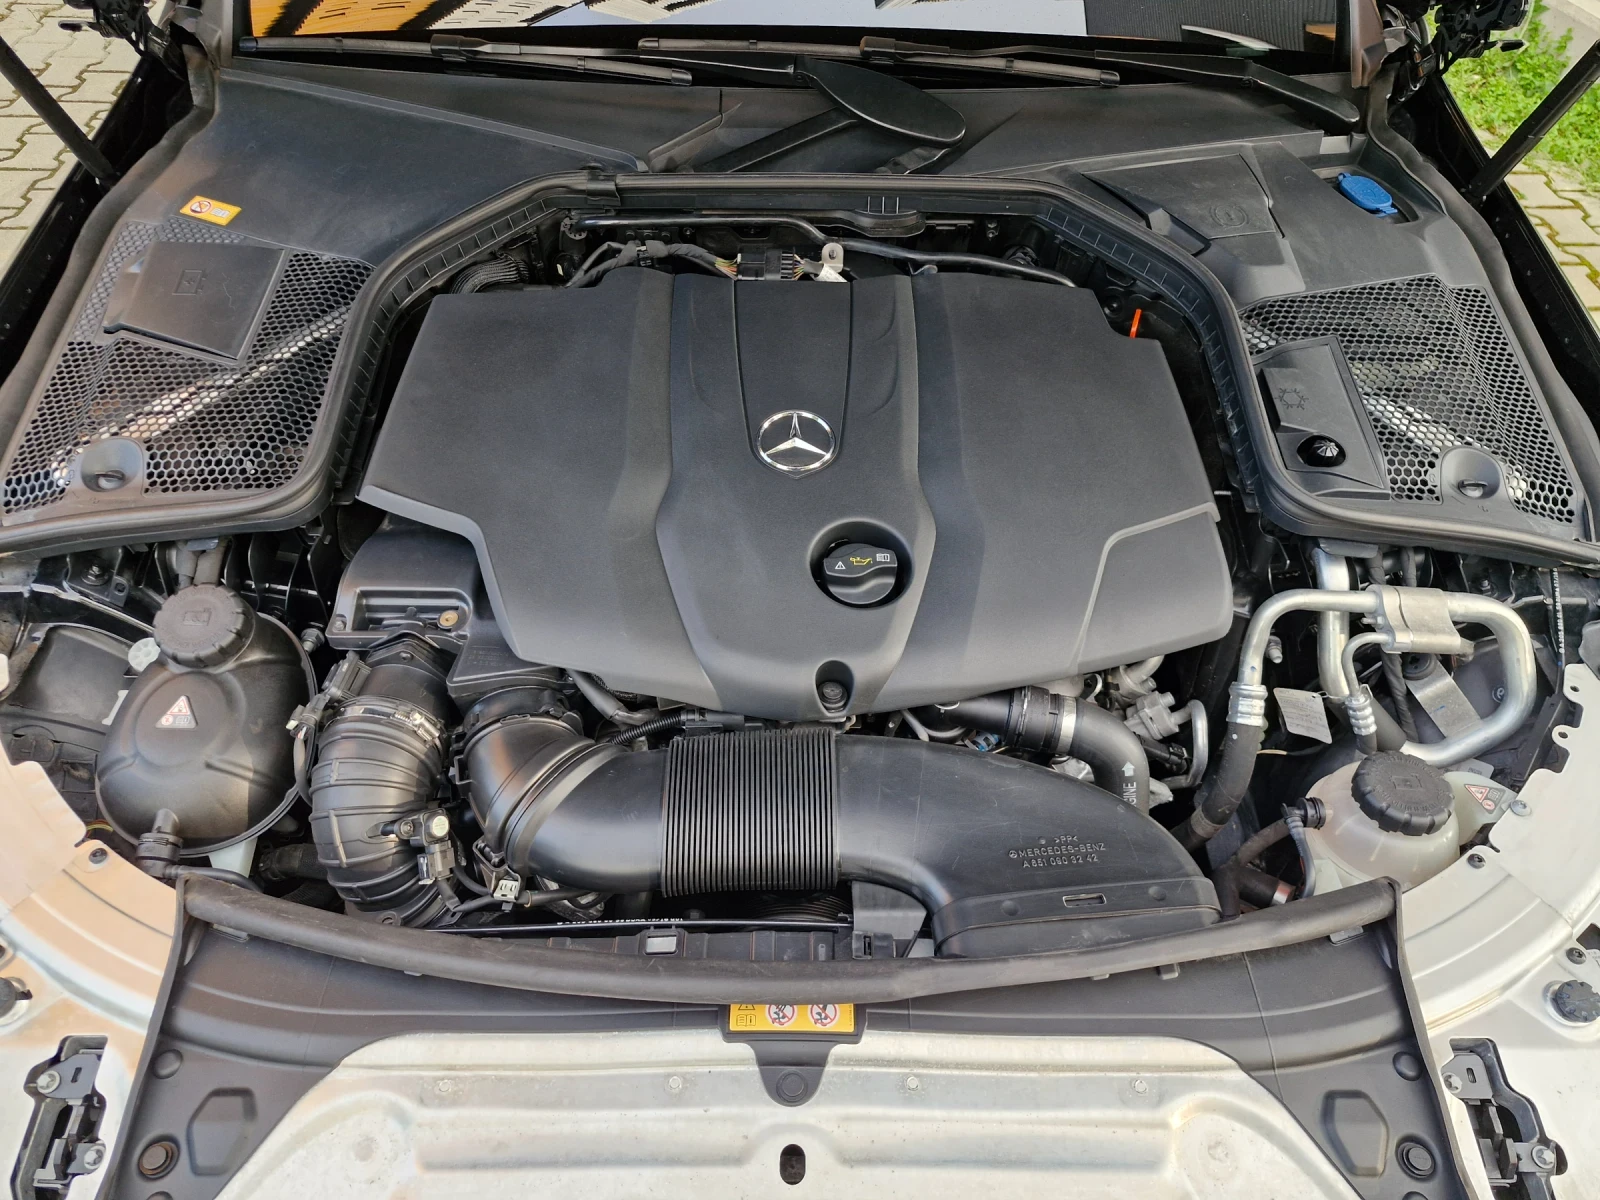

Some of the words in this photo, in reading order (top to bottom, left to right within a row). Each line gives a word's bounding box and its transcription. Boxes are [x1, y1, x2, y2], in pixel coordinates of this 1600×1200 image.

[1123, 782, 1136, 807] GINE
[1018, 842, 1106, 858] MERCEDES-BENZ
[1070, 855, 1083, 864] 32
[1086, 853, 1099, 862] 42
